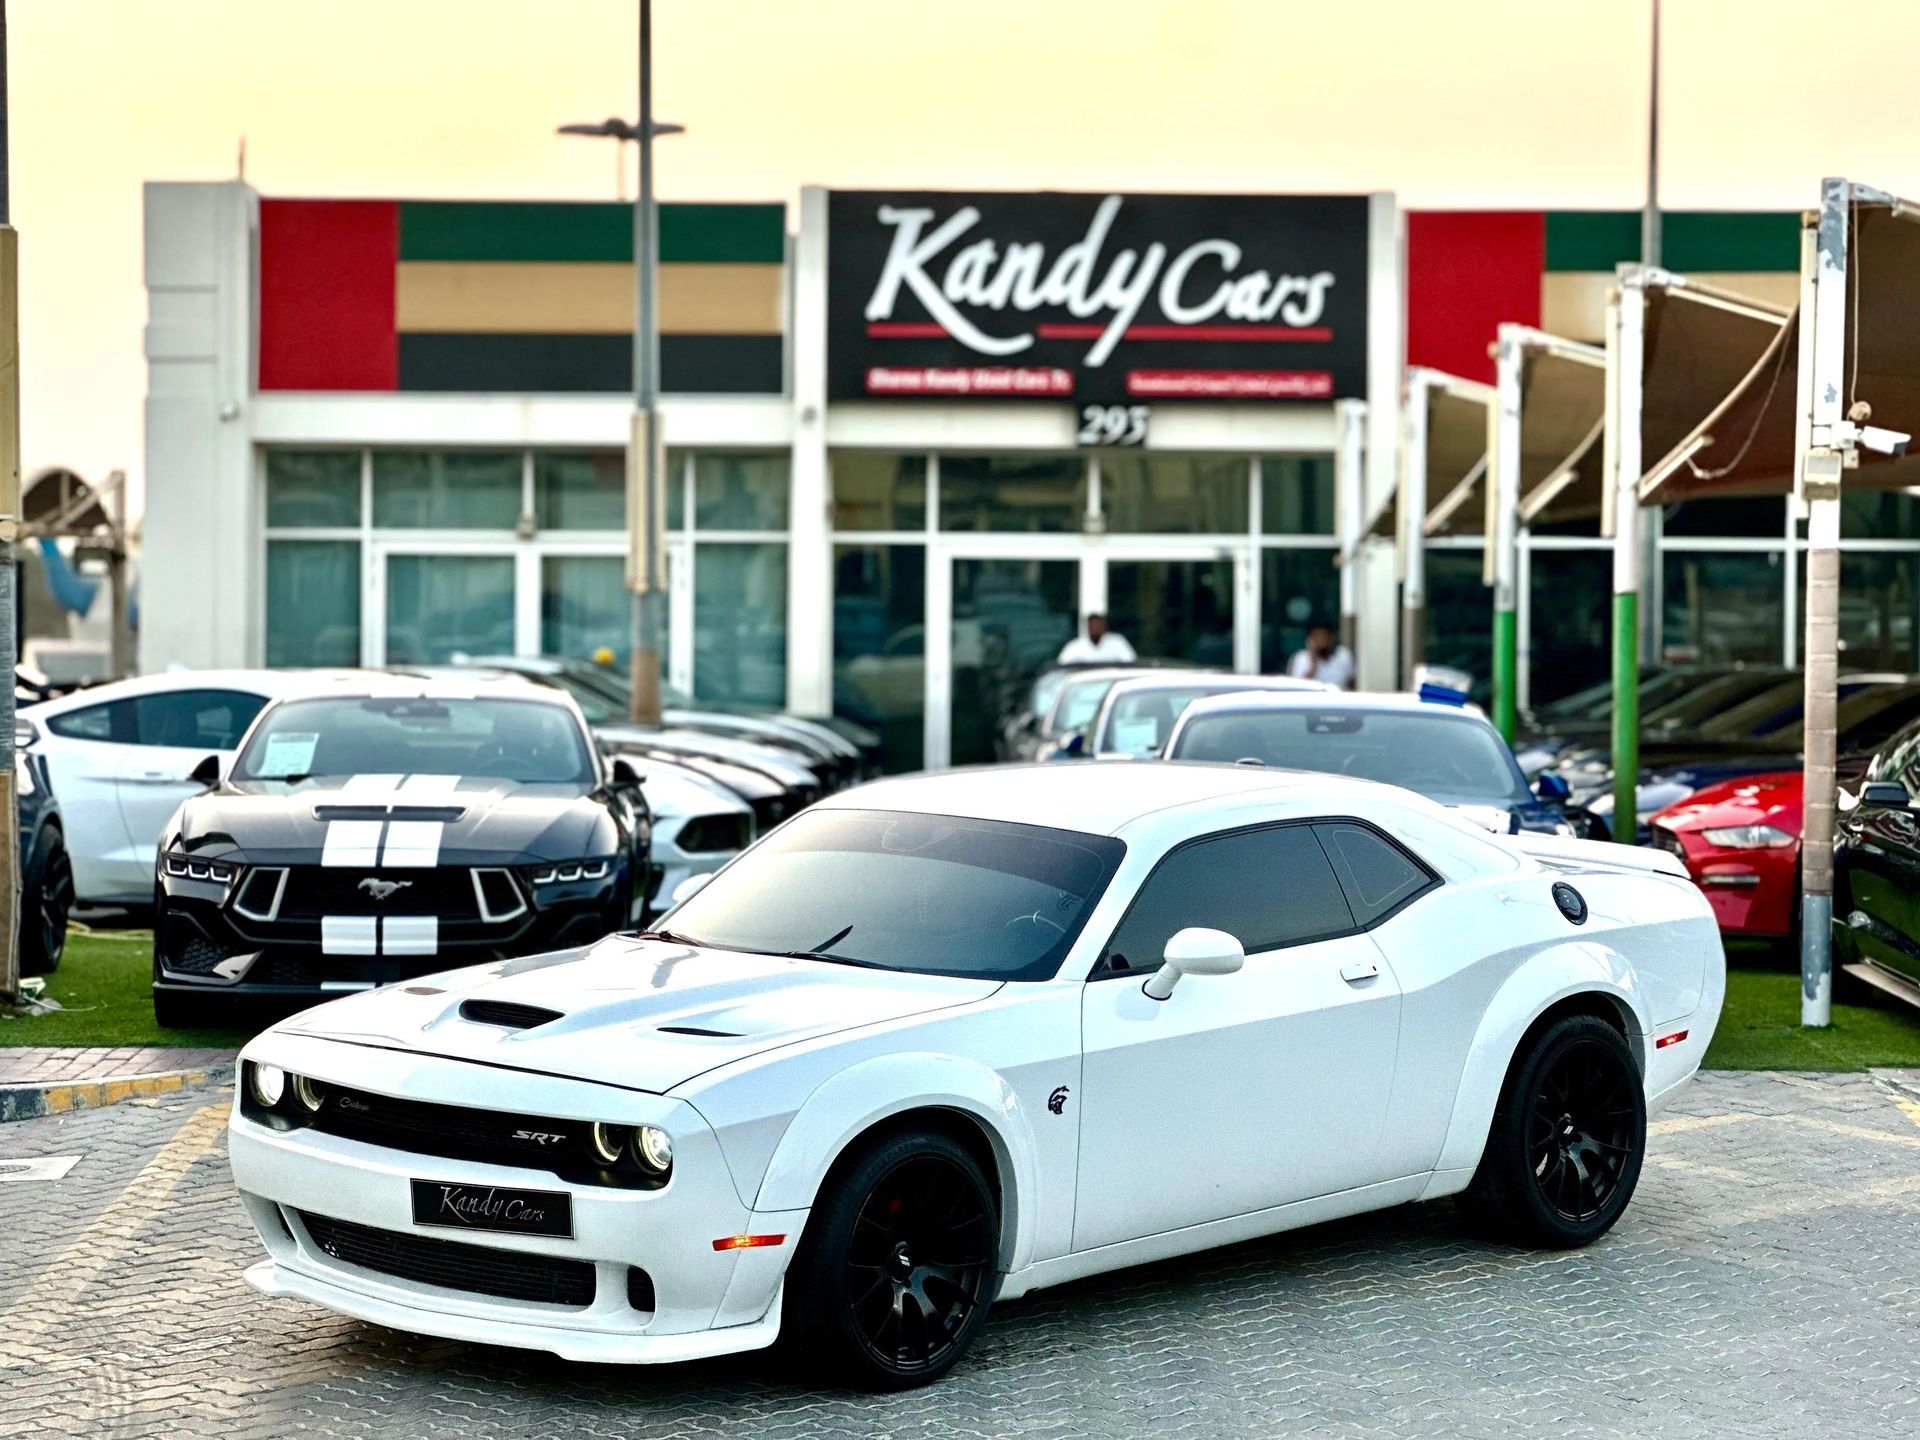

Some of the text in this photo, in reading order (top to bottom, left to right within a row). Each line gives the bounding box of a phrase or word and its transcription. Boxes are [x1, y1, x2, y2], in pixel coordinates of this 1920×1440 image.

[865, 195, 1335, 366] Kandy Cars
[512, 1130, 567, 1145] SRT
[440, 1185, 545, 1228] Kandy Cars
